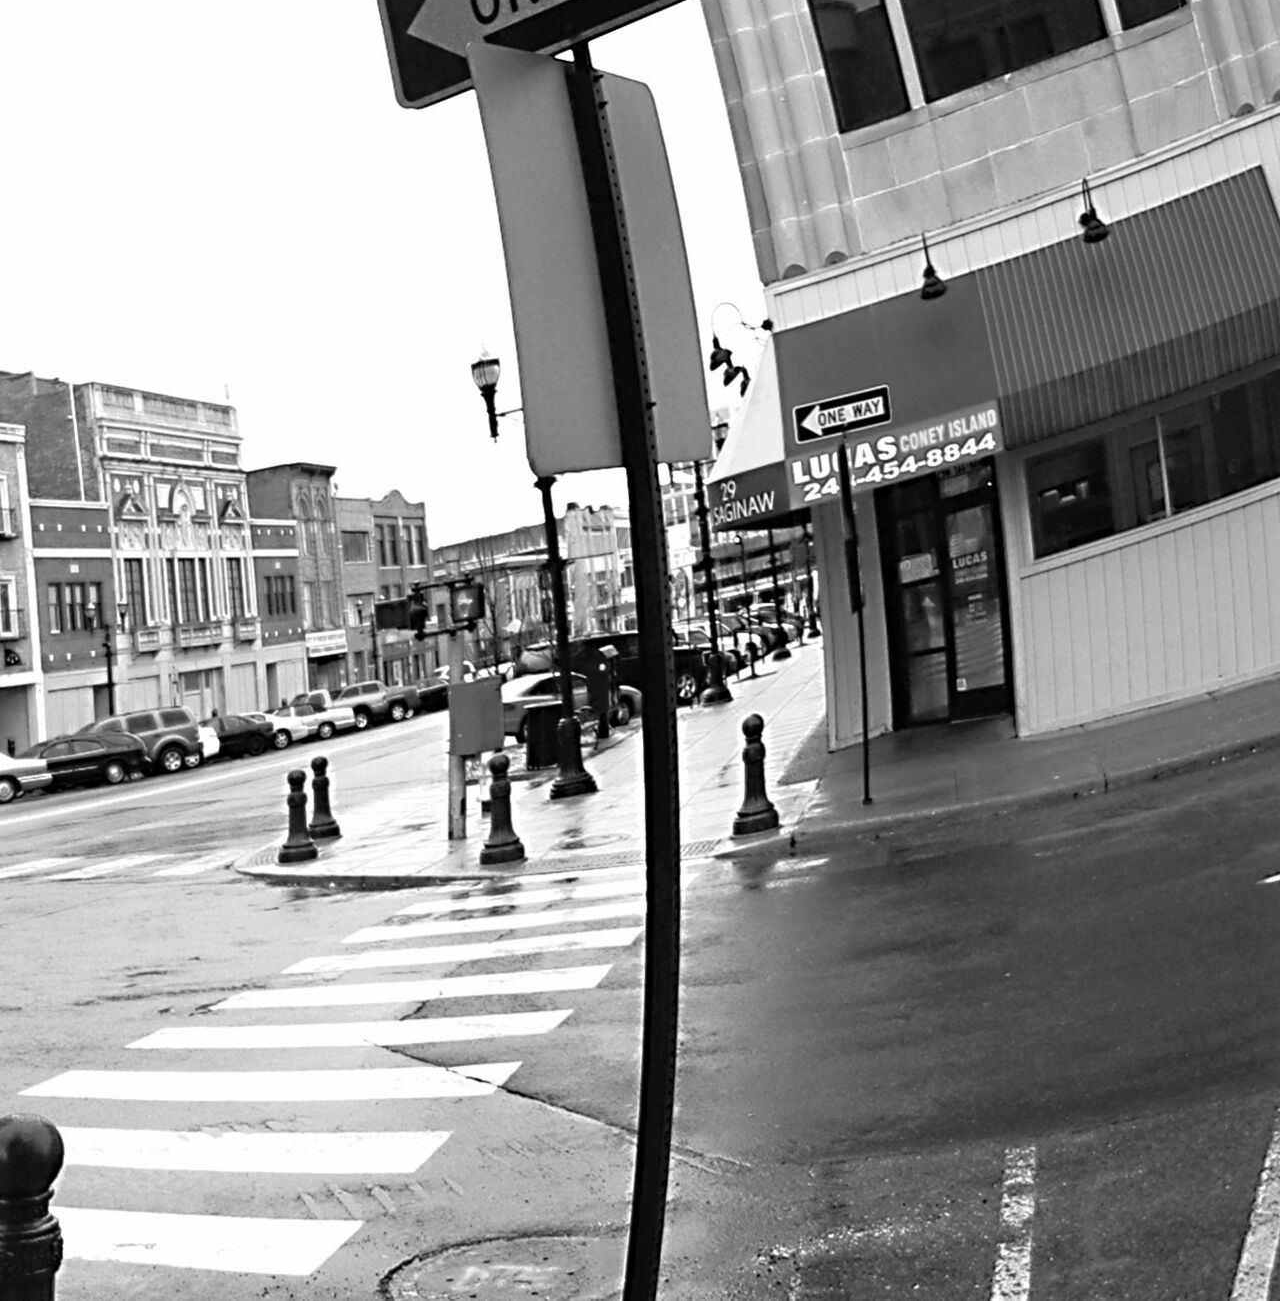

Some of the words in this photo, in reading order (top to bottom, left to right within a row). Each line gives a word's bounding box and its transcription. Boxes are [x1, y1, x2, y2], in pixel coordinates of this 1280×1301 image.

[817, 408, 847, 427] ONE
[852, 399, 881, 418] WAY
[899, 426, 945, 453] CONEY
[948, 409, 998, 439] ISLAND
[803, 432, 996, 502] 24-454-8844
[720, 480, 737, 502] 29
[713, 490, 775, 526] SAGINAW
[952, 550, 988, 569] LUCAS
